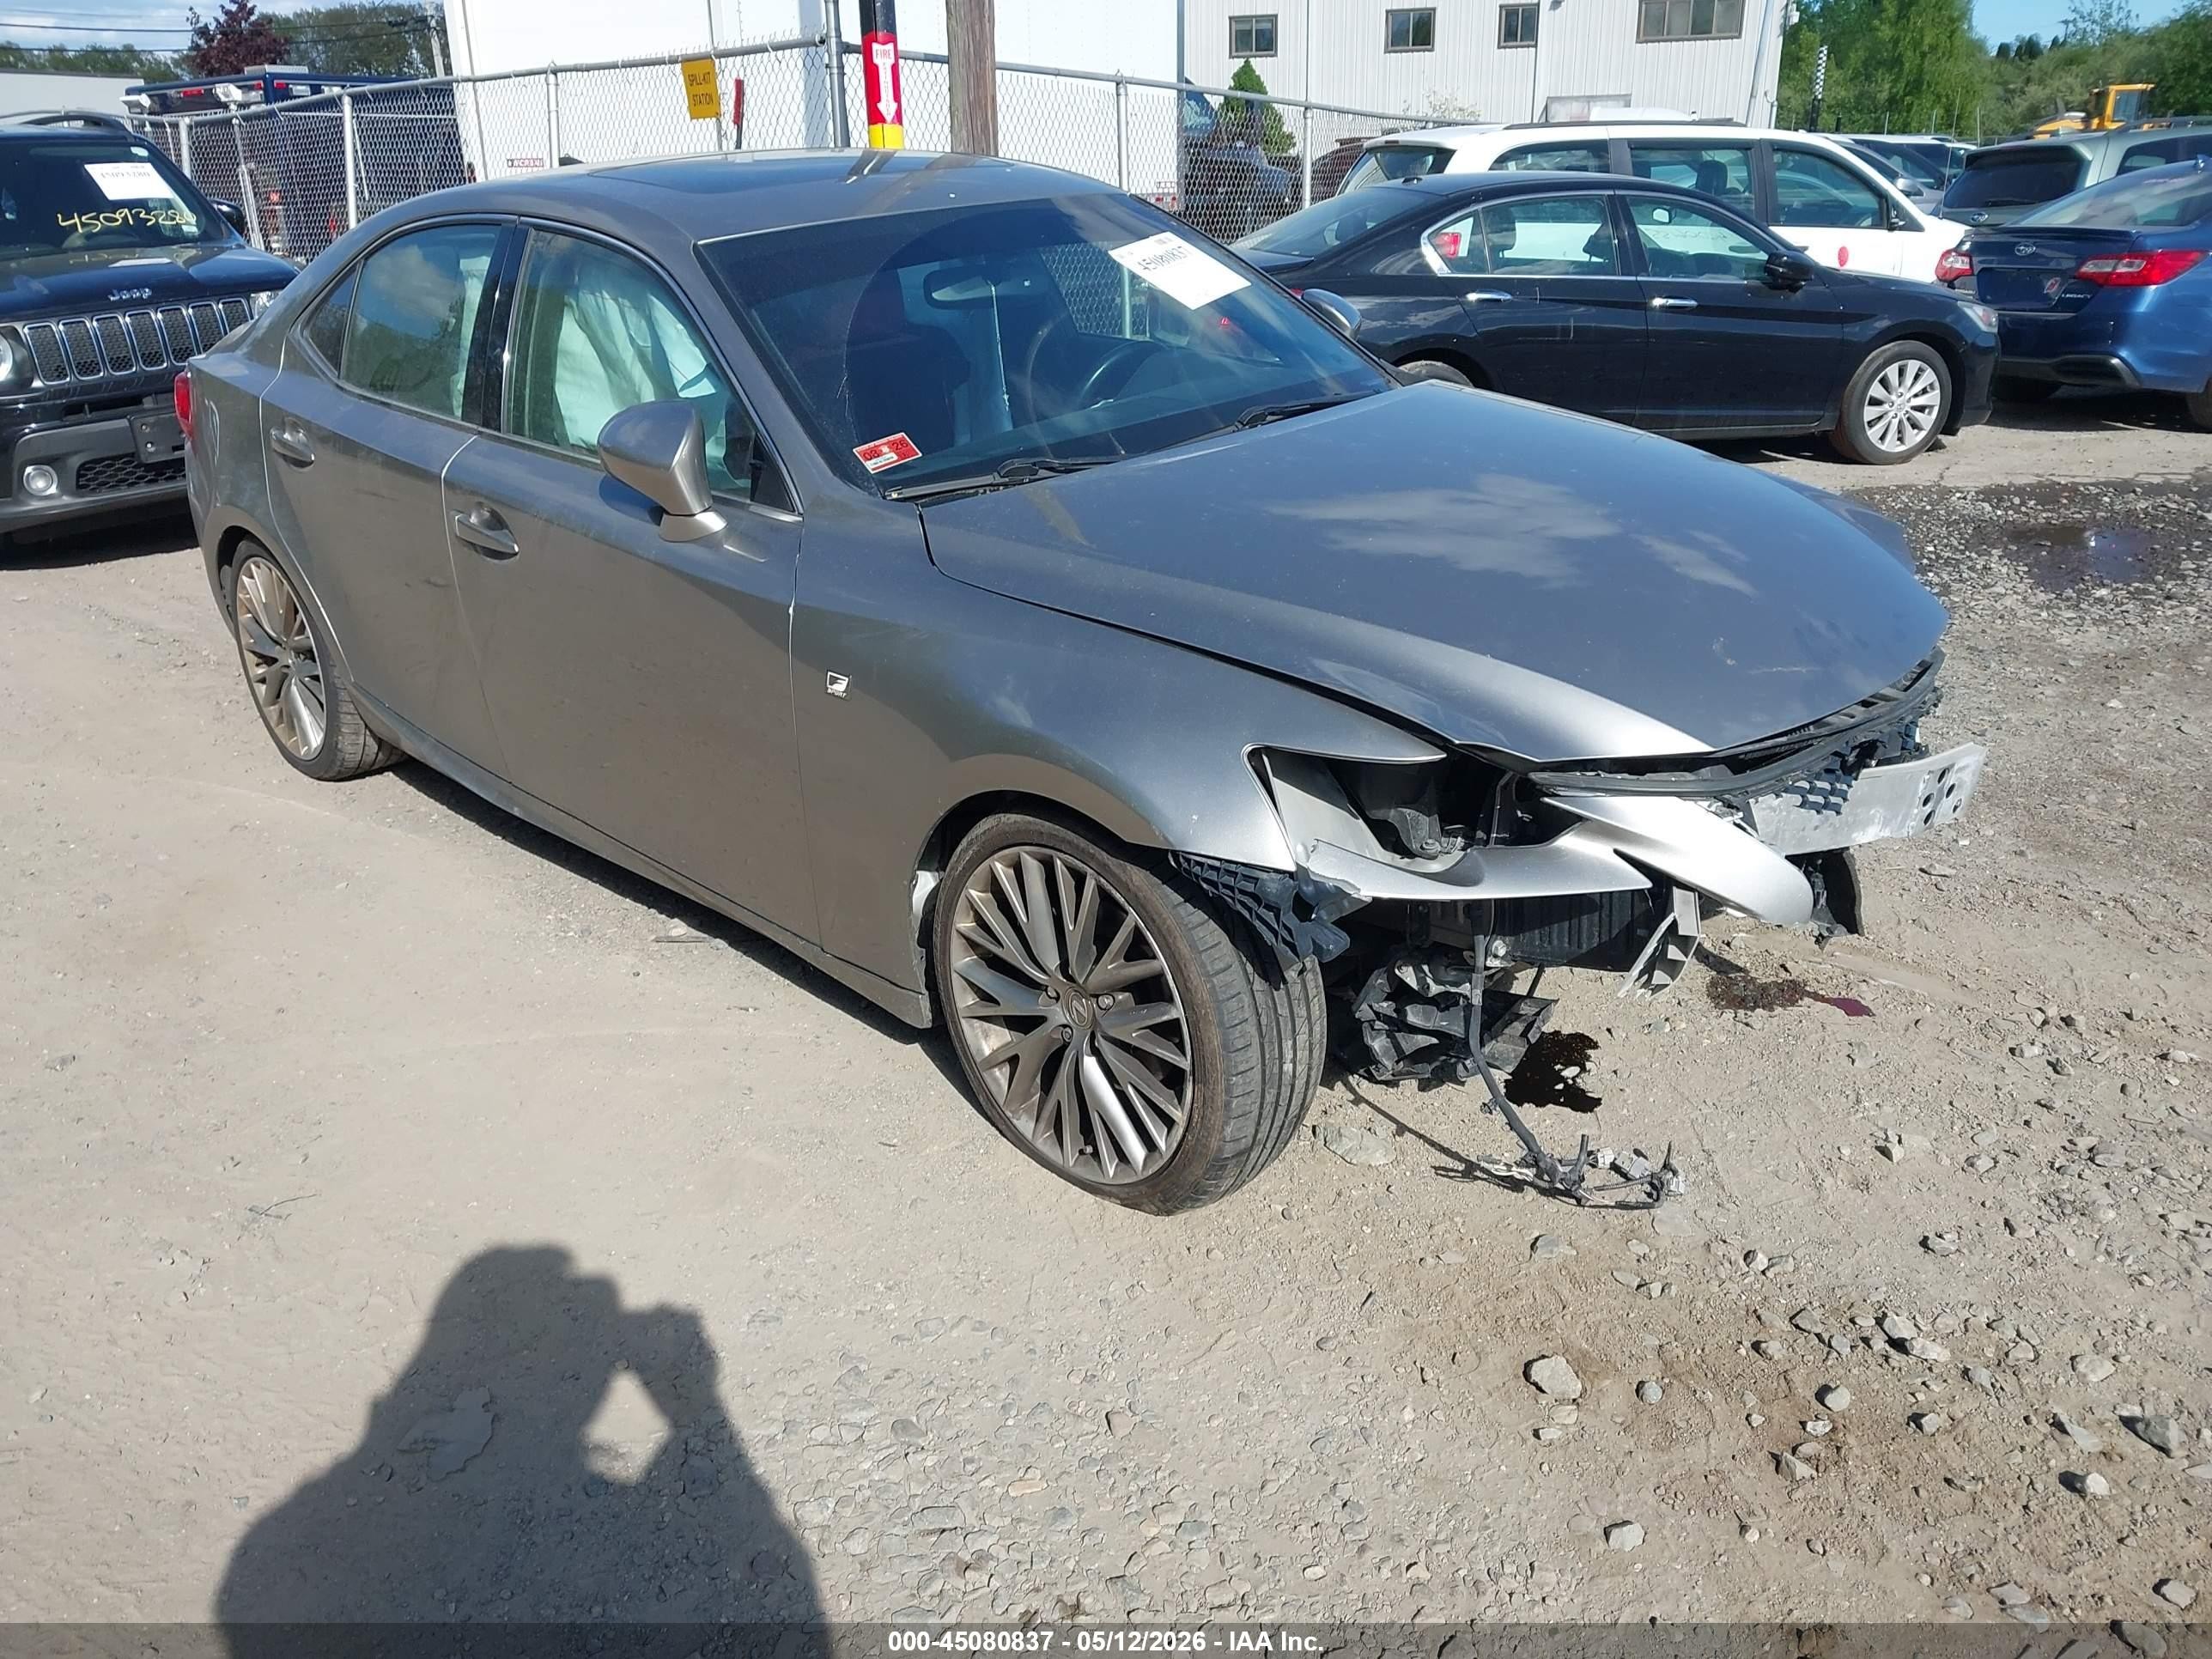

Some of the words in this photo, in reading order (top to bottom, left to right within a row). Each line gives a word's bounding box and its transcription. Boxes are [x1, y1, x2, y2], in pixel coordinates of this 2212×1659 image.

[875, 48, 892, 59] FIRE
[692, 92, 714, 107] STATION
[57, 208, 197, 234] 45093280
[107, 288, 152, 301] Jeep
[891, 439, 908, 452] 26
